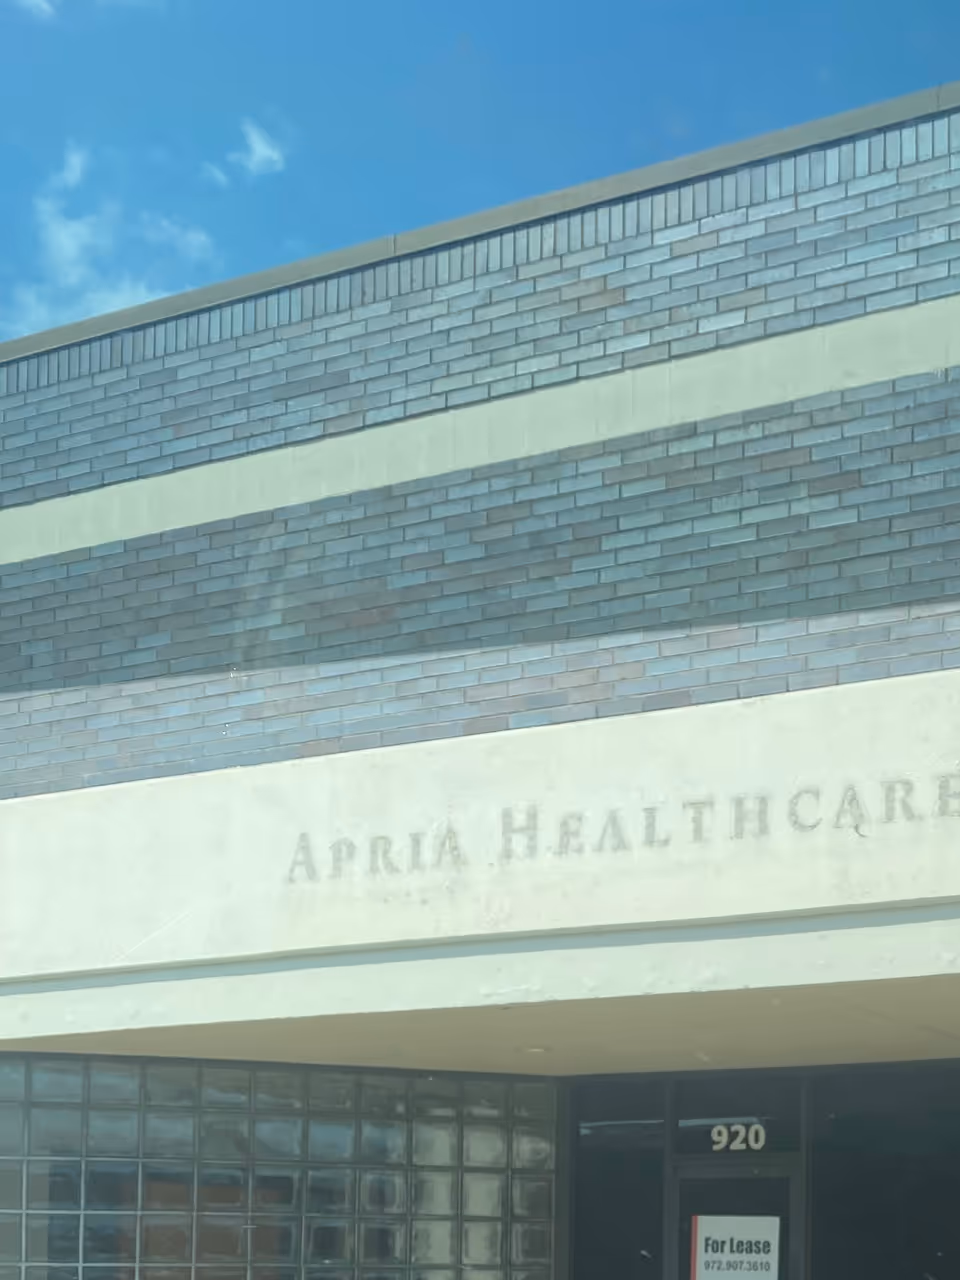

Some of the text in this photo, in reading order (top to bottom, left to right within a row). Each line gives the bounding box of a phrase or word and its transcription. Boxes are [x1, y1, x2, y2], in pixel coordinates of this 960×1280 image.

[287, 823, 468, 884] APRIA
[711, 1124, 766, 1151] 920
[704, 1236, 771, 1255] For Lease
